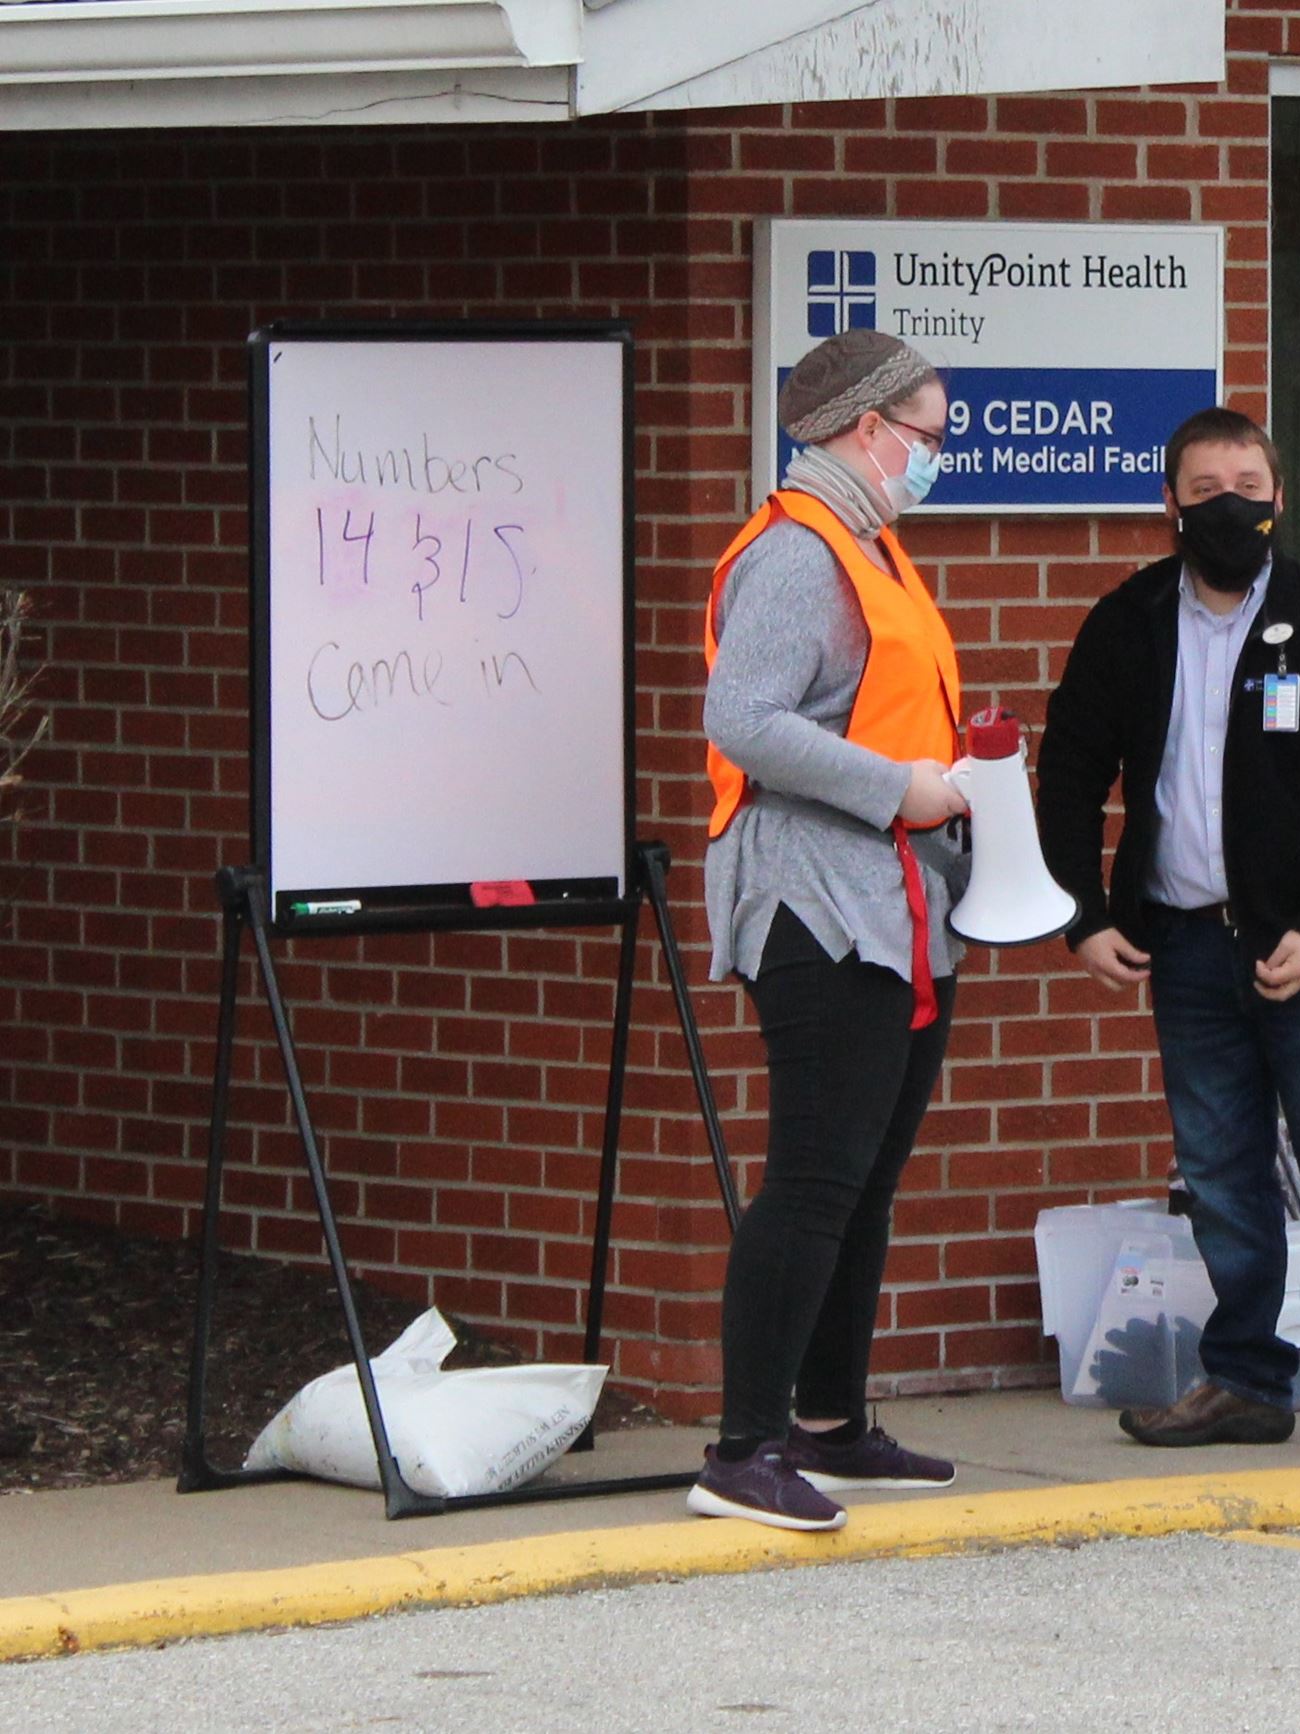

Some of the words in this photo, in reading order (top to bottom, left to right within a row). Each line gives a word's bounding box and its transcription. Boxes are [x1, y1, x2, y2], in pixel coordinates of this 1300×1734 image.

[893, 252, 1071, 295] UnityPoint
[1082, 255, 1188, 289] Health
[893, 308, 985, 344] Trinity
[948, 400, 971, 436] 9
[982, 400, 1114, 436] CEDAR
[308, 413, 524, 494] Numbers
[938, 448, 984, 474] ent
[991, 445, 1095, 474] Medical
[1104, 445, 1167, 474] Facil
[316, 507, 375, 587] 14
[460, 518, 524, 620] 15
[473, 637, 543, 699] in
